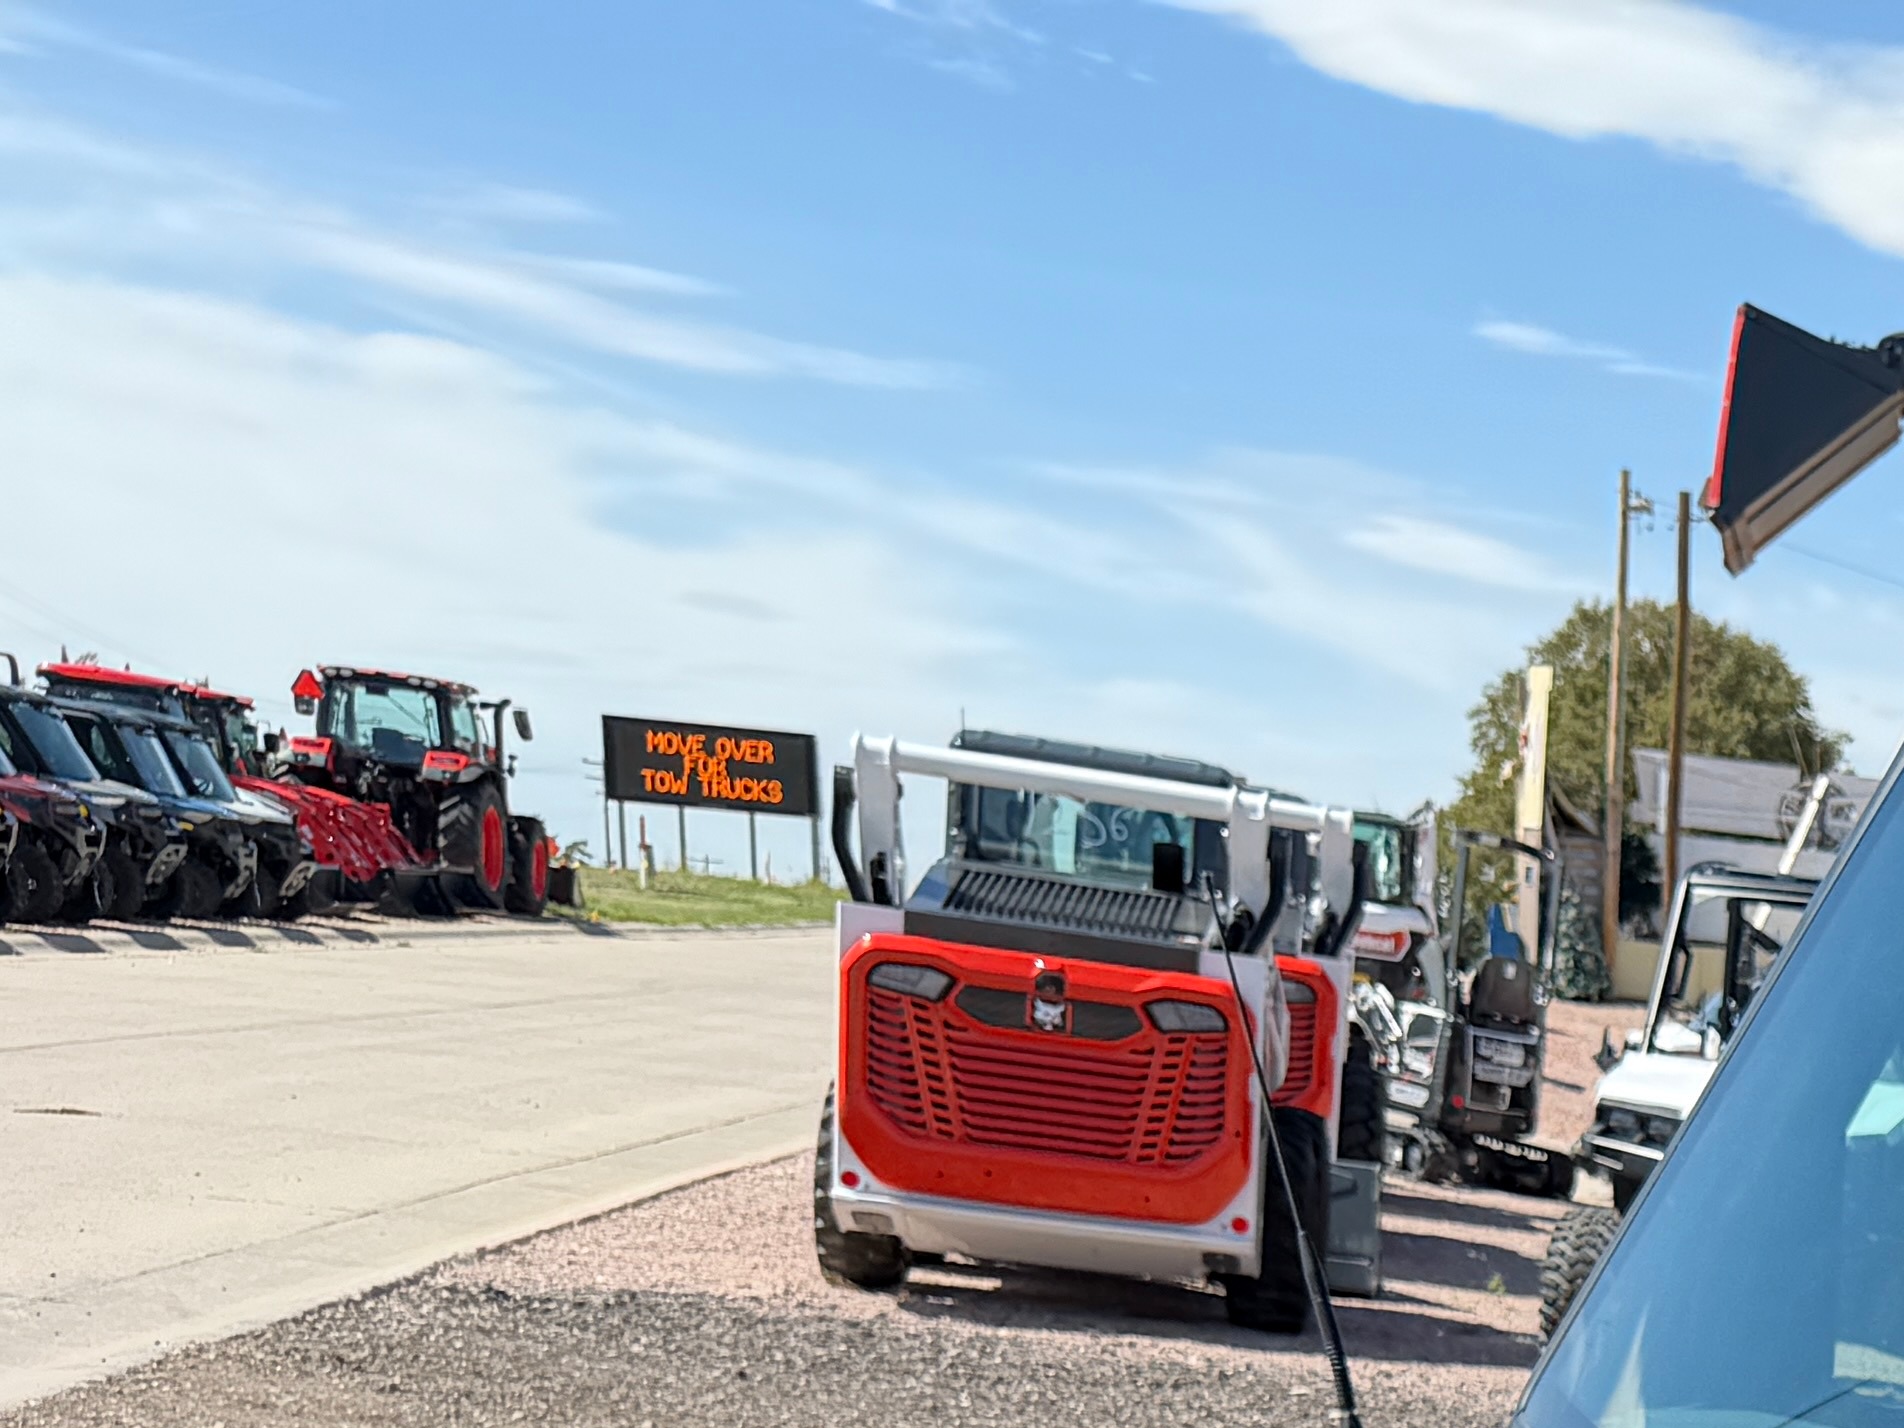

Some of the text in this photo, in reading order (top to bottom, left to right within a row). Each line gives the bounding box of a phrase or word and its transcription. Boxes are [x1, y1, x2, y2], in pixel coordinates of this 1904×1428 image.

[645, 729, 775, 765] MOVE OVER
[683, 751, 728, 779] FOR
[640, 768, 784, 804] TOW TRUCKS
